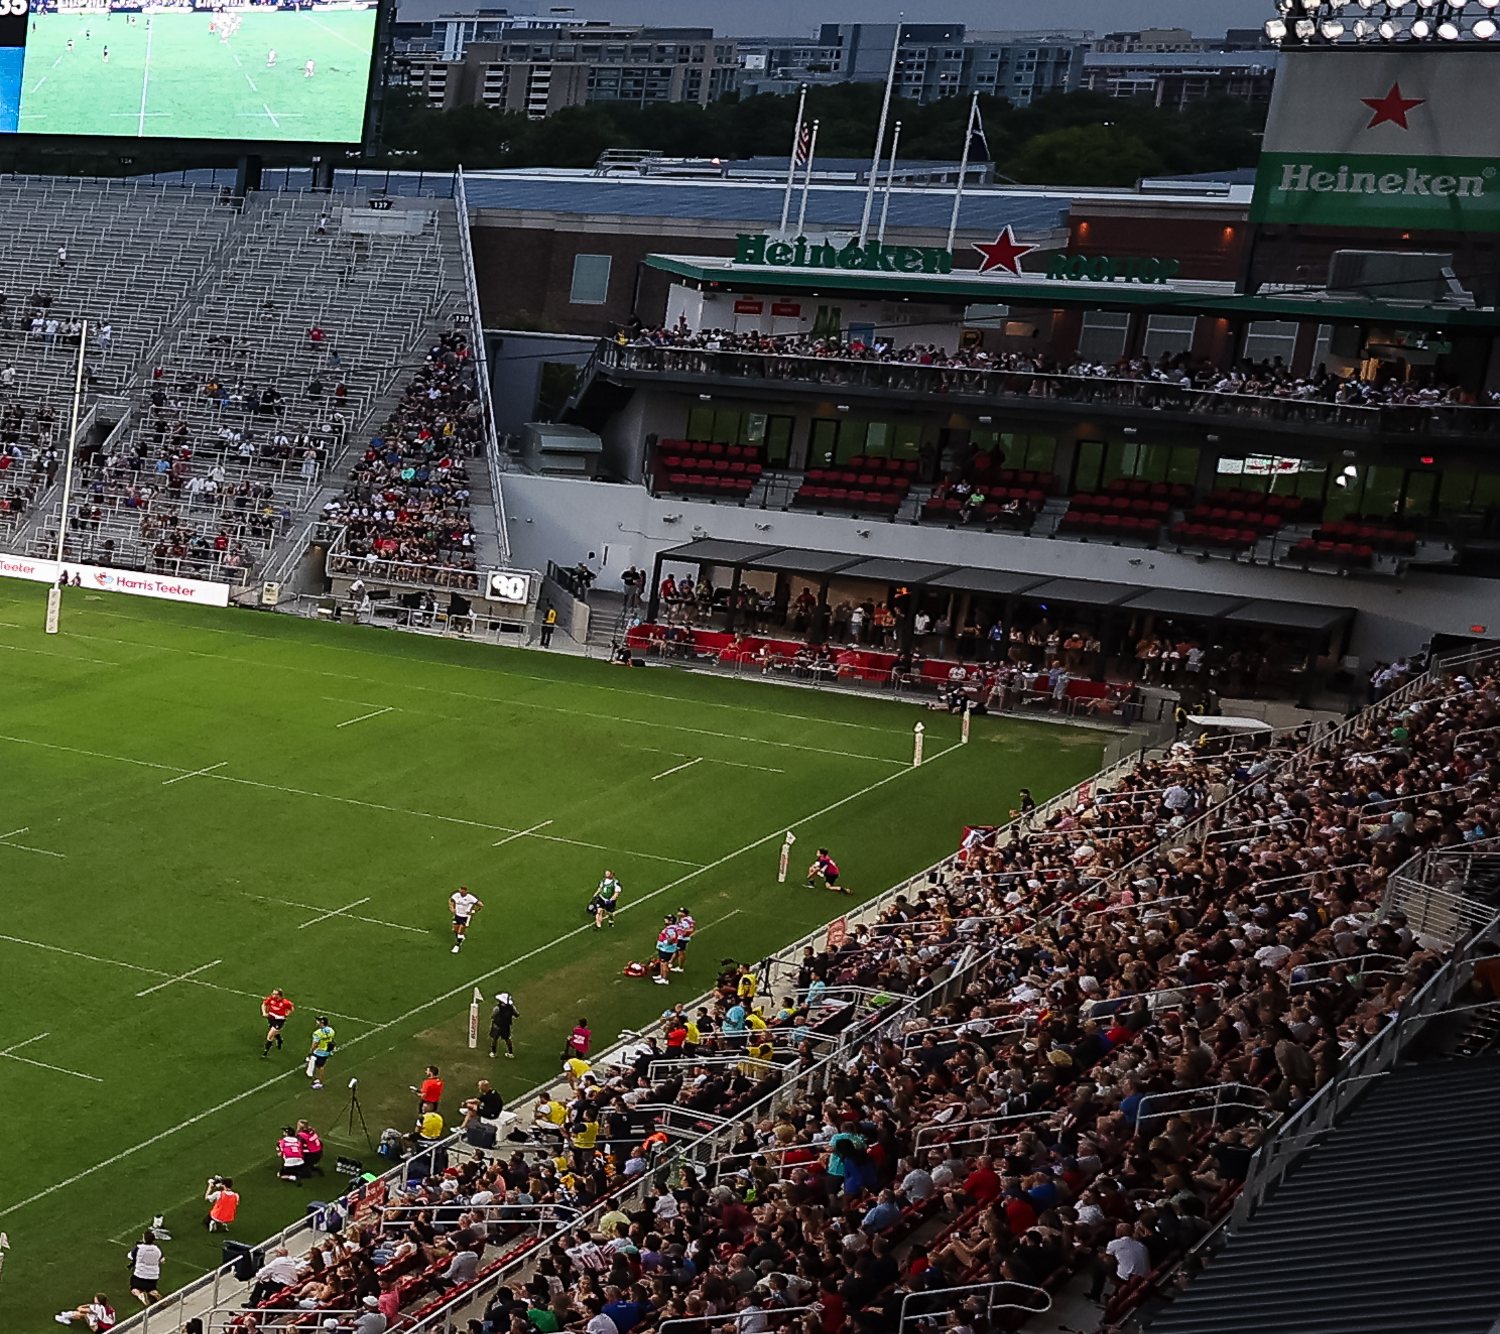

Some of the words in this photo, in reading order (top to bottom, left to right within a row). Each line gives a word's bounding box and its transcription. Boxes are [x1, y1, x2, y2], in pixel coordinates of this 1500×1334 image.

[735, 233, 953, 274] Heineken
[0, 561, 34, 573] Teeter
[117, 577, 153, 590] Harris
[155, 582, 195, 596] Teeter
